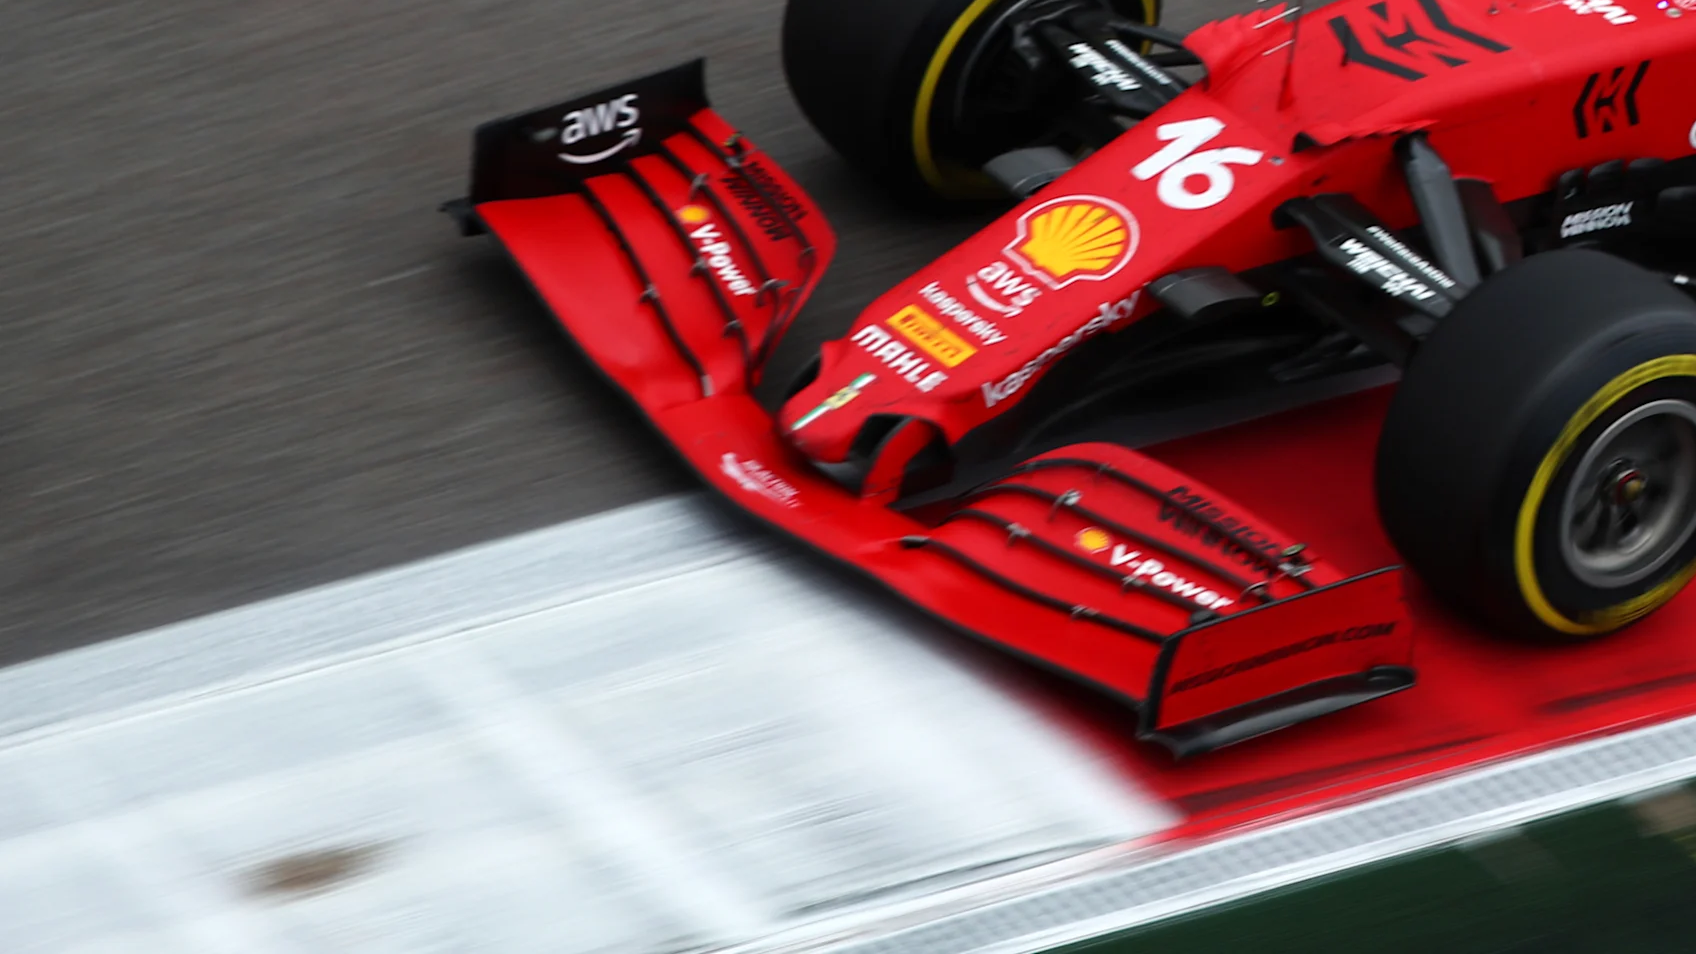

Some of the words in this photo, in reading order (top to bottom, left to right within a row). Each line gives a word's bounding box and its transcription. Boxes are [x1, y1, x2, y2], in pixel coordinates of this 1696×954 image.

[561, 93, 640, 145] aws
[1131, 117, 1264, 210] 16
[690, 223, 757, 298] V-Power
[976, 261, 1043, 307] aws
[919, 280, 1008, 346] kaspersky
[851, 324, 949, 393] MAHLE
[1109, 543, 1235, 610] V-Power
